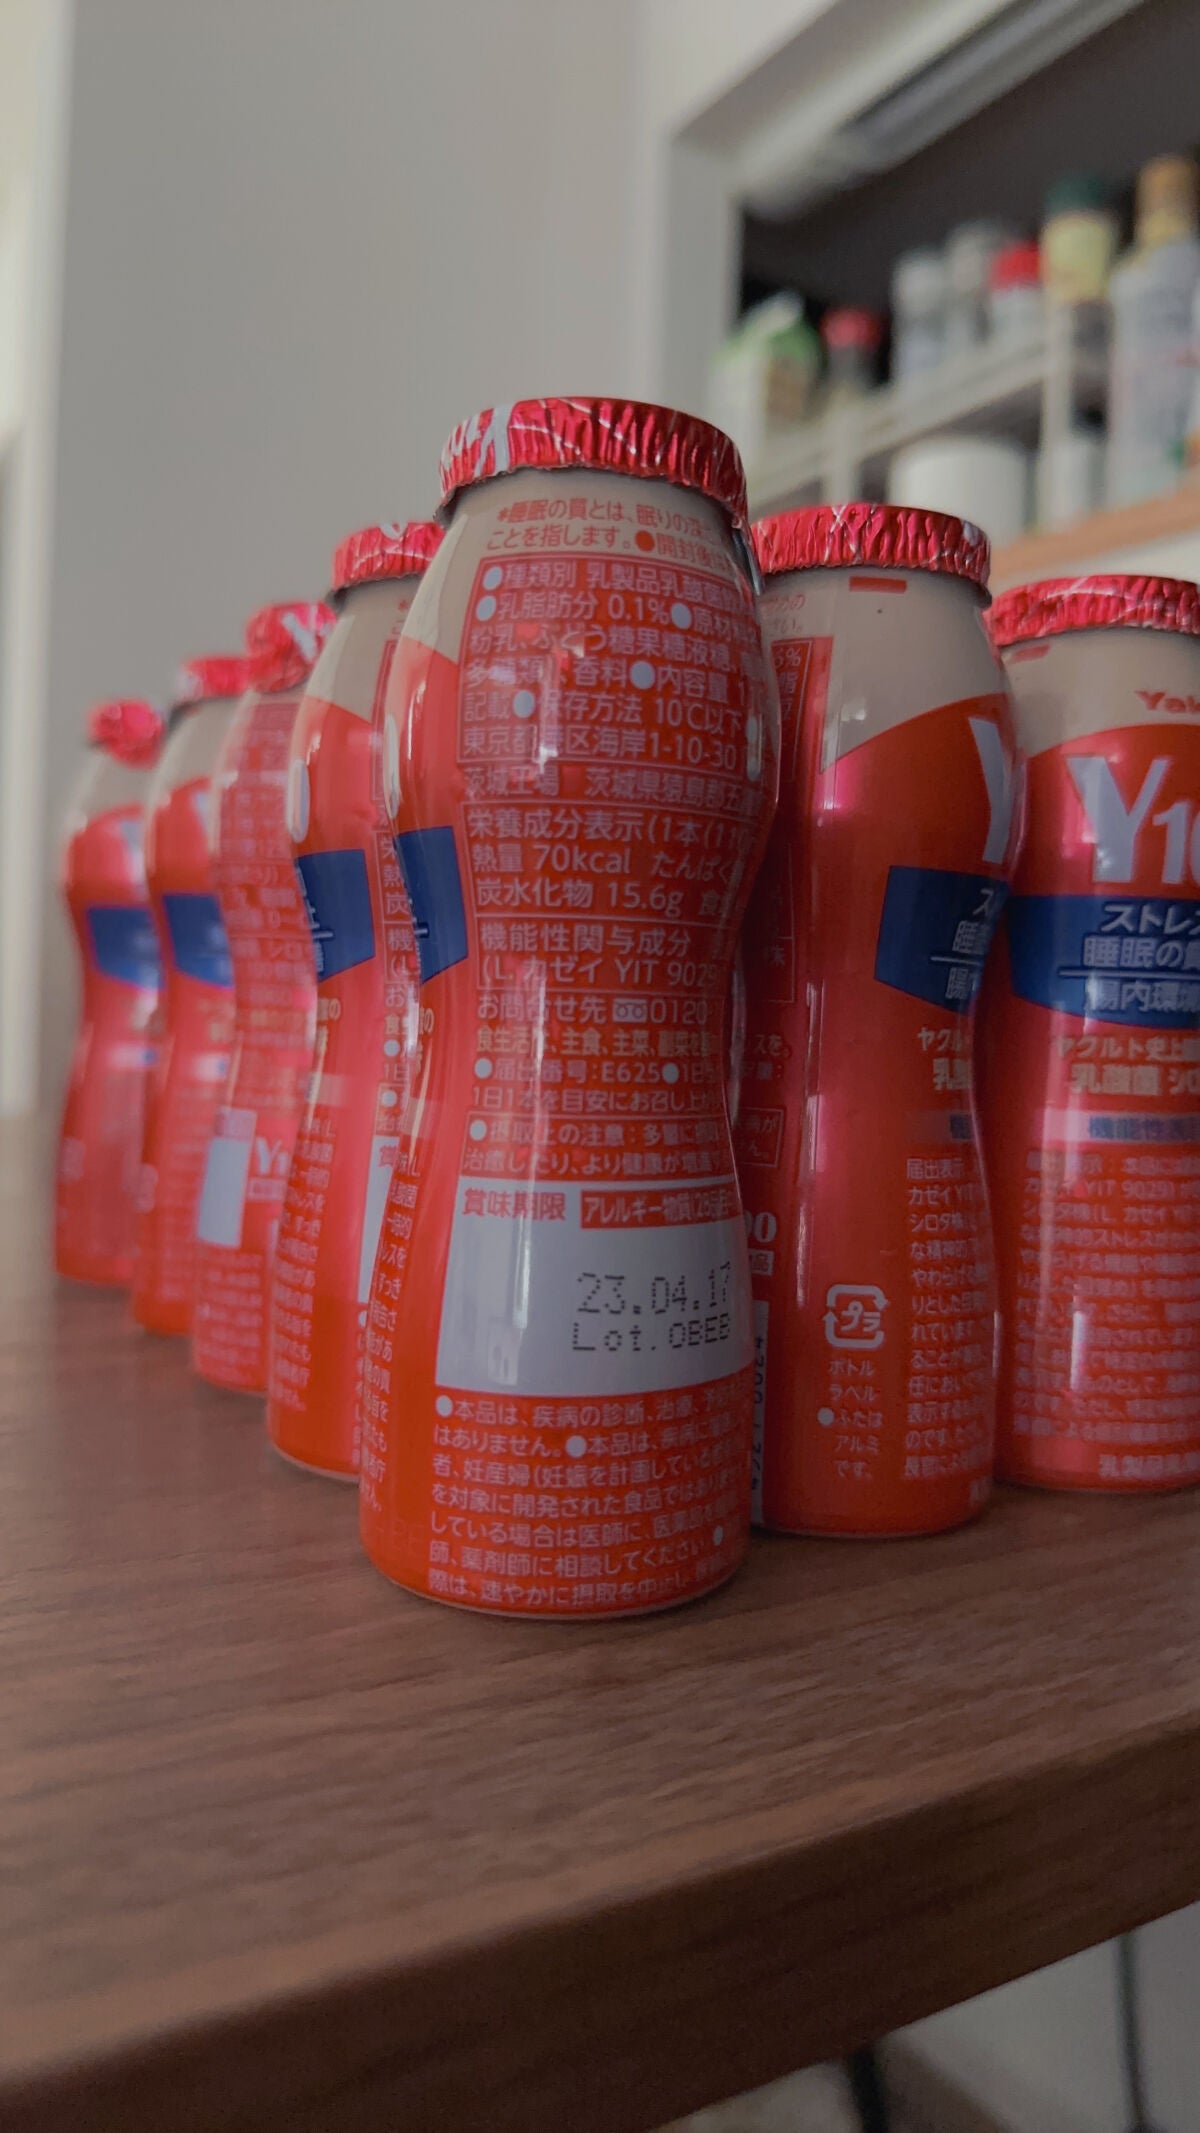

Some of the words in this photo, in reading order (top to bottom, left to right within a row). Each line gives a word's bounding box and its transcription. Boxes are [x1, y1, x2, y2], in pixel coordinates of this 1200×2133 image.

[487, 523, 631, 549] ことを指します。
[504, 561, 577, 590] 種類別
[497, 590, 599, 621] 乳脂肪分
[607, 595, 670, 626] 0.1%
[472, 844, 524, 874] 熱量
[532, 844, 631, 876] 70kcal
[476, 878, 595, 909] 炭水化物
[607, 881, 684, 919] 15.6g
[480, 920, 692, 959] 機能性関与成分
[614, 957, 661, 985] YIT
[460, 1187, 566, 1222] 賞味期限
[576, 1260, 731, 1315] 23.04.17
[839, 1300, 881, 1333] プラ
[828, 1358, 875, 1378] ボトル
[828, 1383, 877, 1403] ラベル
[433, 1423, 563, 1459] はありません。
[834, 1434, 880, 1455] アルミ
